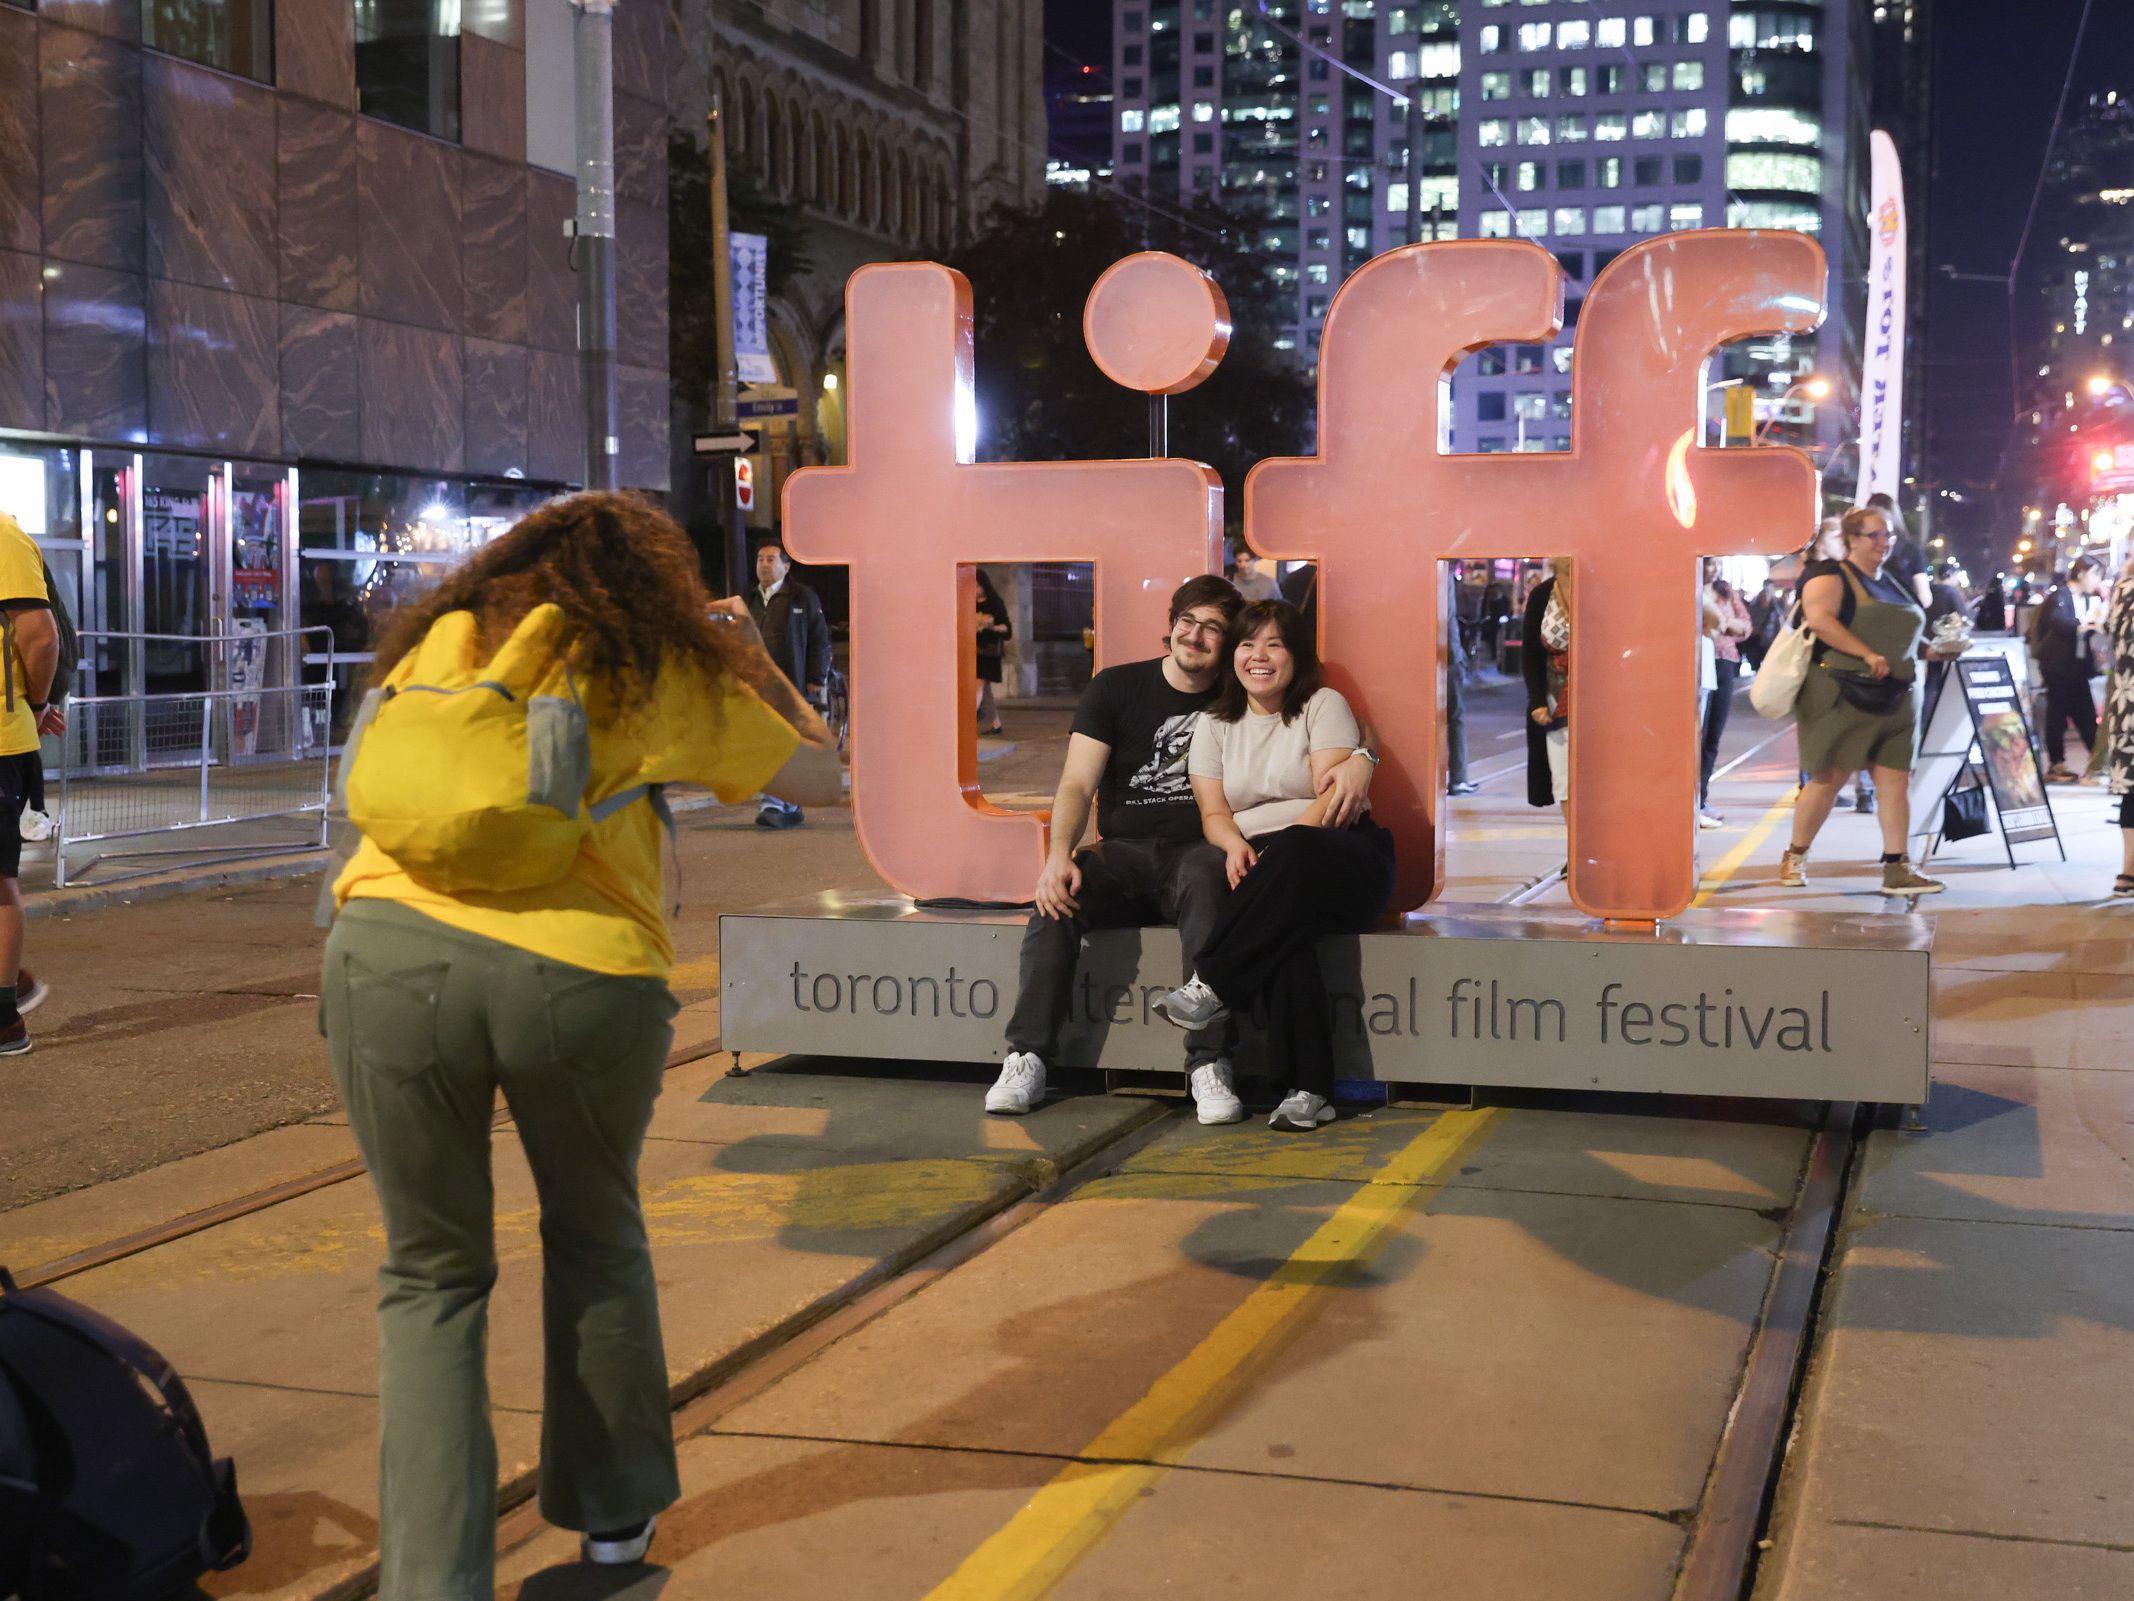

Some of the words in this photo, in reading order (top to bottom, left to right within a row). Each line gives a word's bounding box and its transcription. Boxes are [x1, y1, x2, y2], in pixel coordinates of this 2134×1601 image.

[781, 229, 1829, 926] tiff
[789, 961, 999, 1019] toronto
[1446, 978, 1566, 1042] film
[1596, 983, 1832, 1053] festival
